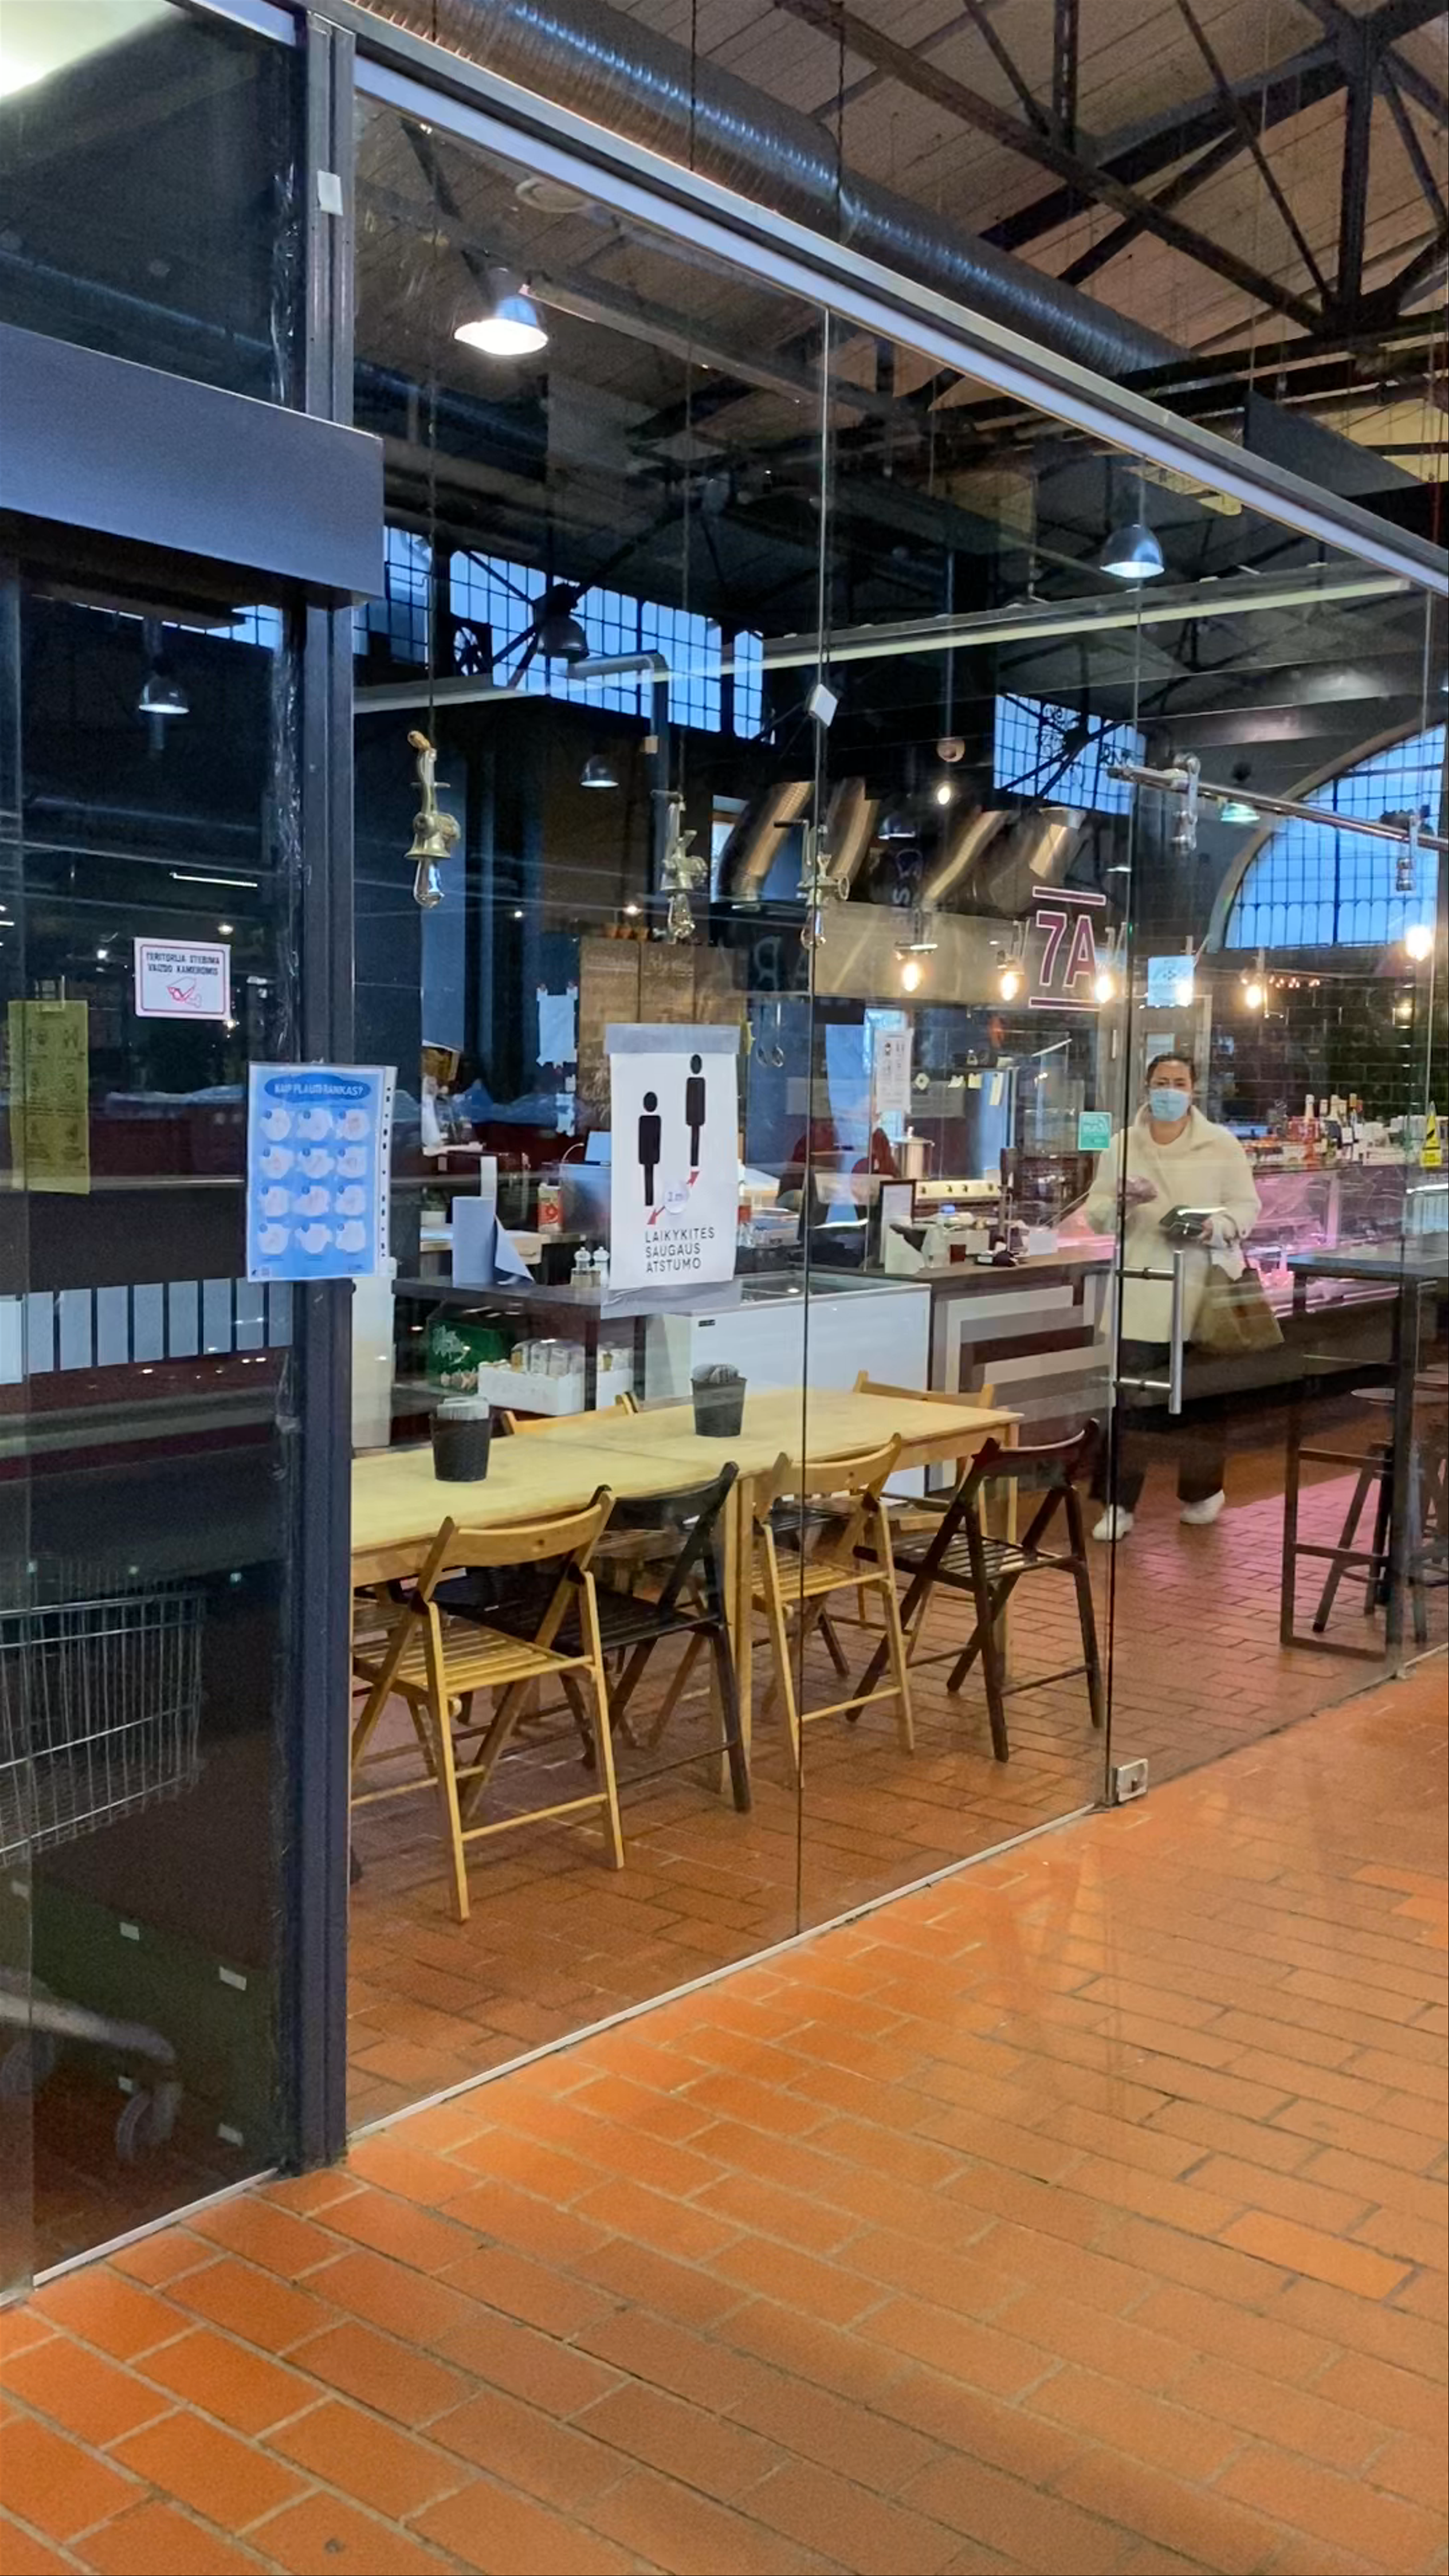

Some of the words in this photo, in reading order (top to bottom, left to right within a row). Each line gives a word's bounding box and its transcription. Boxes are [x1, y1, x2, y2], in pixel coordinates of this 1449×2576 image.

[1036, 910, 1098, 987] 7A
[646, 1243, 701, 1258] SAUGAUS
[646, 1258, 701, 1273] ATSTUMO
